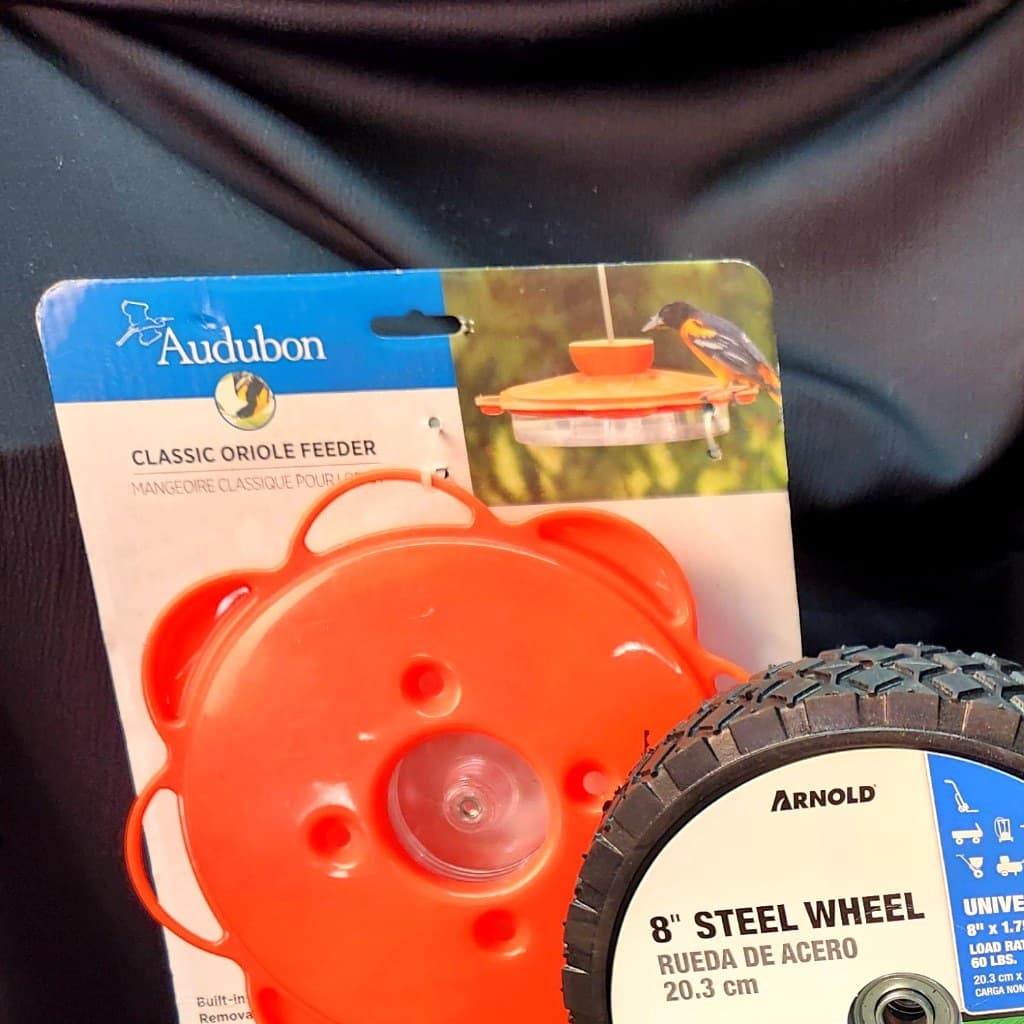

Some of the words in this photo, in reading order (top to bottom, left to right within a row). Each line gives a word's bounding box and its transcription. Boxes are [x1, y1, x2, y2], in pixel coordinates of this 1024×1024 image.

[157, 324, 327, 366] Audubon
[132, 447, 216, 466] CLASSIC
[221, 443, 296, 462] ORIOLE
[300, 439, 377, 459] FEEDER
[131, 477, 215, 497] MANGEOIRE
[218, 475, 291, 494] CLASSIQUE
[296, 472, 336, 490] POUR
[771, 785, 876, 812] ARNOLD
[649, 914, 681, 943] 8"
[694, 904, 799, 939] STEEL
[804, 892, 925, 929] WHEEL
[966, 923, 984, 937] 8"
[988, 925, 998, 935] x
[657, 948, 738, 975] RUEDA
[743, 945, 775, 968] DE
[781, 937, 858, 965] ACERO
[969, 942, 1003, 955] LOAD
[971, 957, 987, 969] 60
[990, 954, 1017, 967] LBS.
[973, 975, 996, 985] 20.3
[998, 973, 1014, 982] cm
[664, 977, 716, 1001] 20.3
[723, 977, 759, 996] cm
[975, 987, 1005, 998] CARGA
[196, 994, 245, 1007] Built-in
[199, 1011, 253, 1024] Remova
